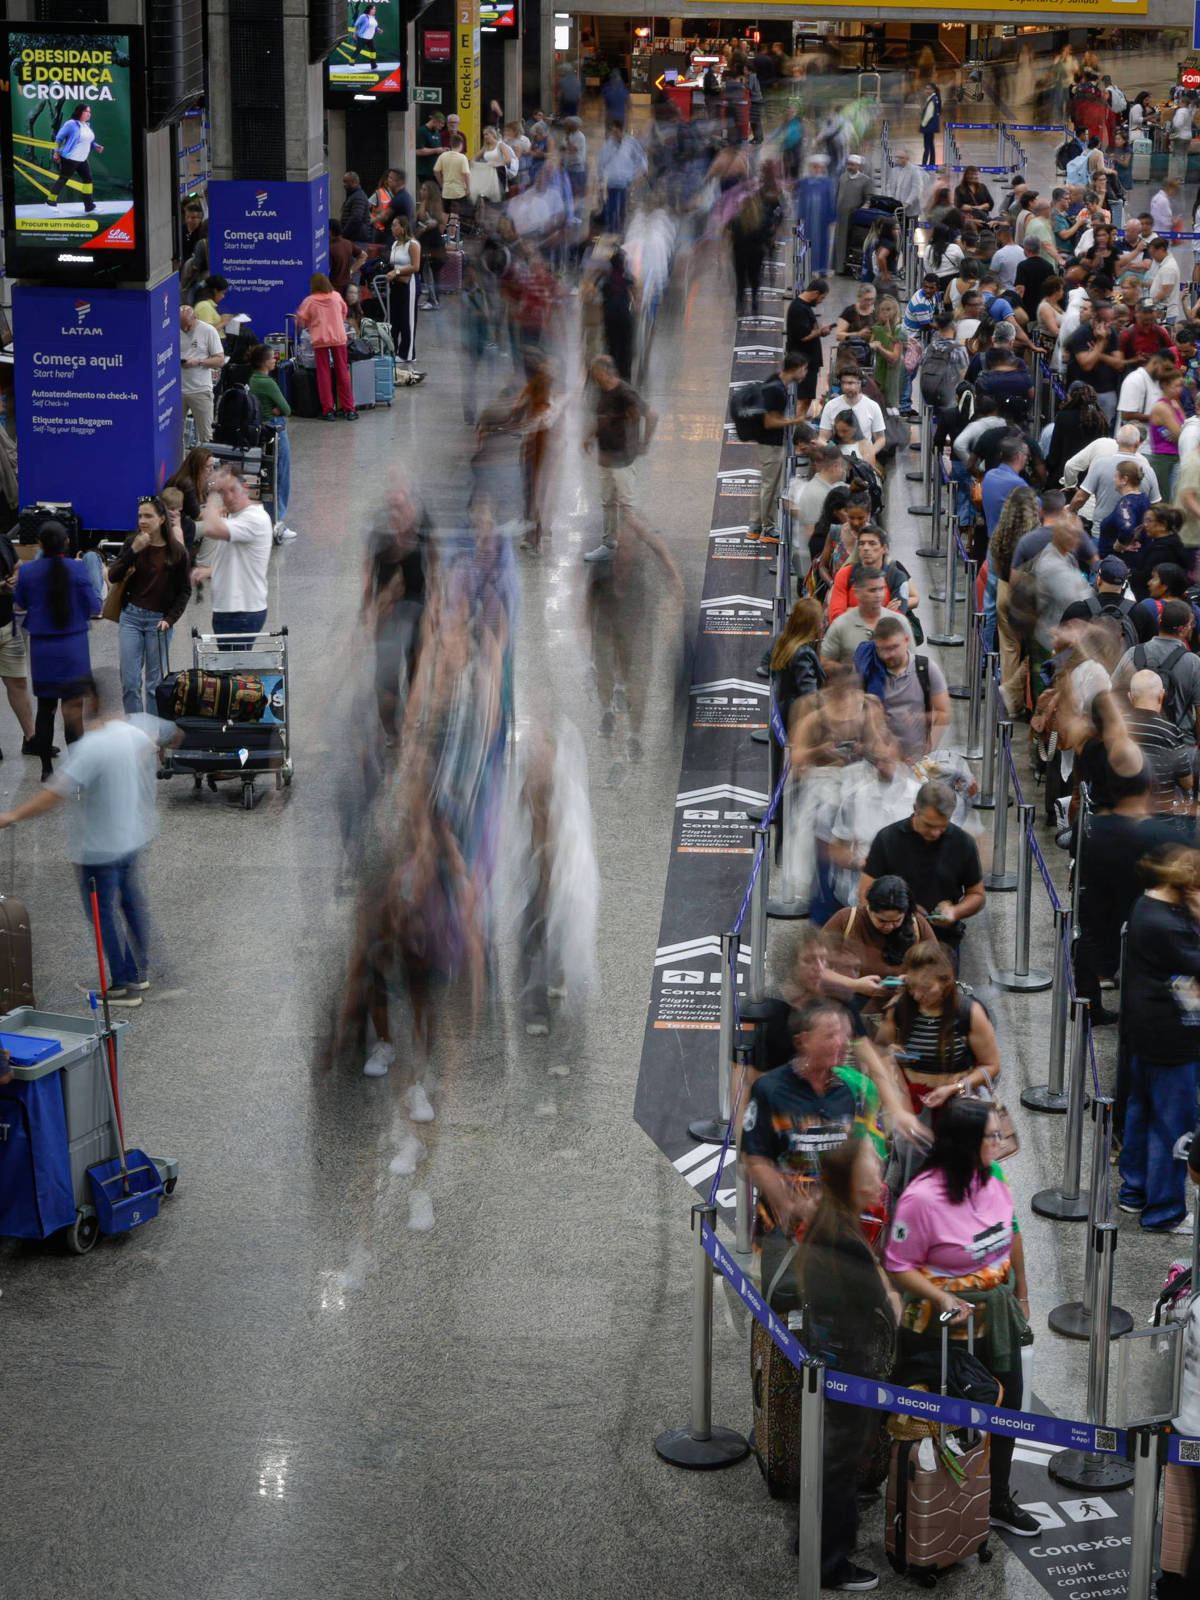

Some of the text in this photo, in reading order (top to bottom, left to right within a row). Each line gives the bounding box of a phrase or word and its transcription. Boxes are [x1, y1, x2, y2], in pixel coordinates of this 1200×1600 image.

[461, 12, 469, 23] 2
[22, 49, 113, 64] OBESIDADE
[22, 64, 113, 87] É DOENÇA
[460, 57, 472, 109] Check-in
[1181, 74, 1200, 83] FOM
[64, 221, 91, 229] médico
[224, 229, 292, 243] Começa aqui!
[62, 327, 103, 336] LATAM
[33, 352, 123, 370] Começa aqui!
[33, 369, 75, 379] Start here!
[32, 390, 139, 401] Autoatendimento no check-in
[32, 416, 64, 426] Etiquete
[79, 417, 113, 428] Bagagem
[826, 1380, 848, 1392] olar
[897, 1396, 941, 1413] decolar
[990, 1416, 1036, 1431] decolar
[1029, 1536, 1132, 1558] Conexõe
[1047, 1561, 1096, 1576] Flight
[1057, 1569, 1130, 1587] connecti
[1069, 1585, 1128, 1600] Conexi
